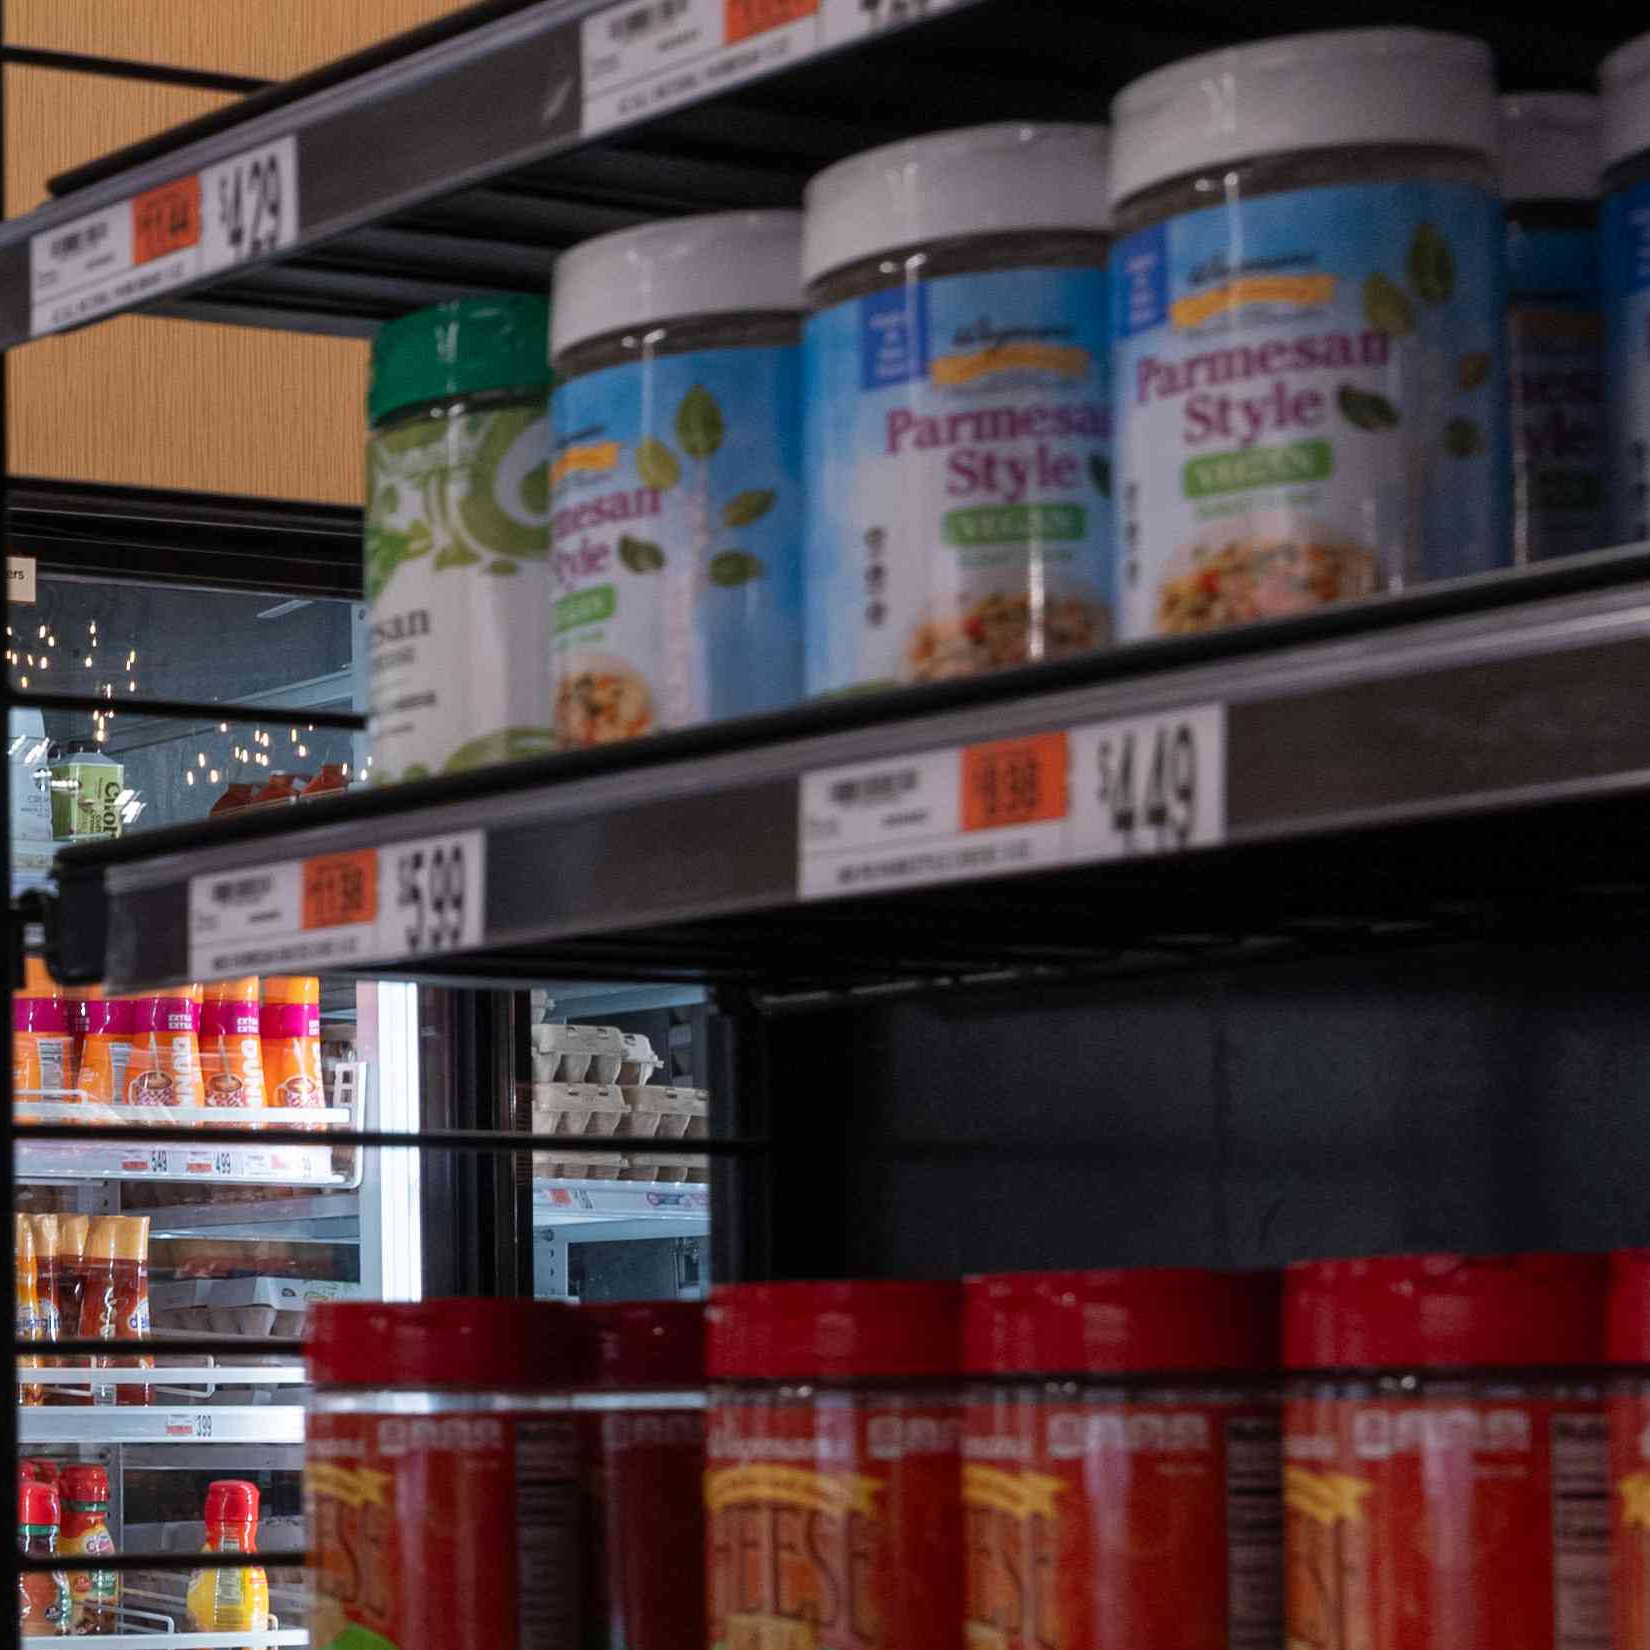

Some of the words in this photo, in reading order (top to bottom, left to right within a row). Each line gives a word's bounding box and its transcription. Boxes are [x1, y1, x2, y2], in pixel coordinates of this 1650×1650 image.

[1136, 328, 1391, 405] Parmesan
[885, 401, 1115, 456] Parmesa
[1183, 384, 1325, 444] Style
[946, 447, 1080, 502] Style
